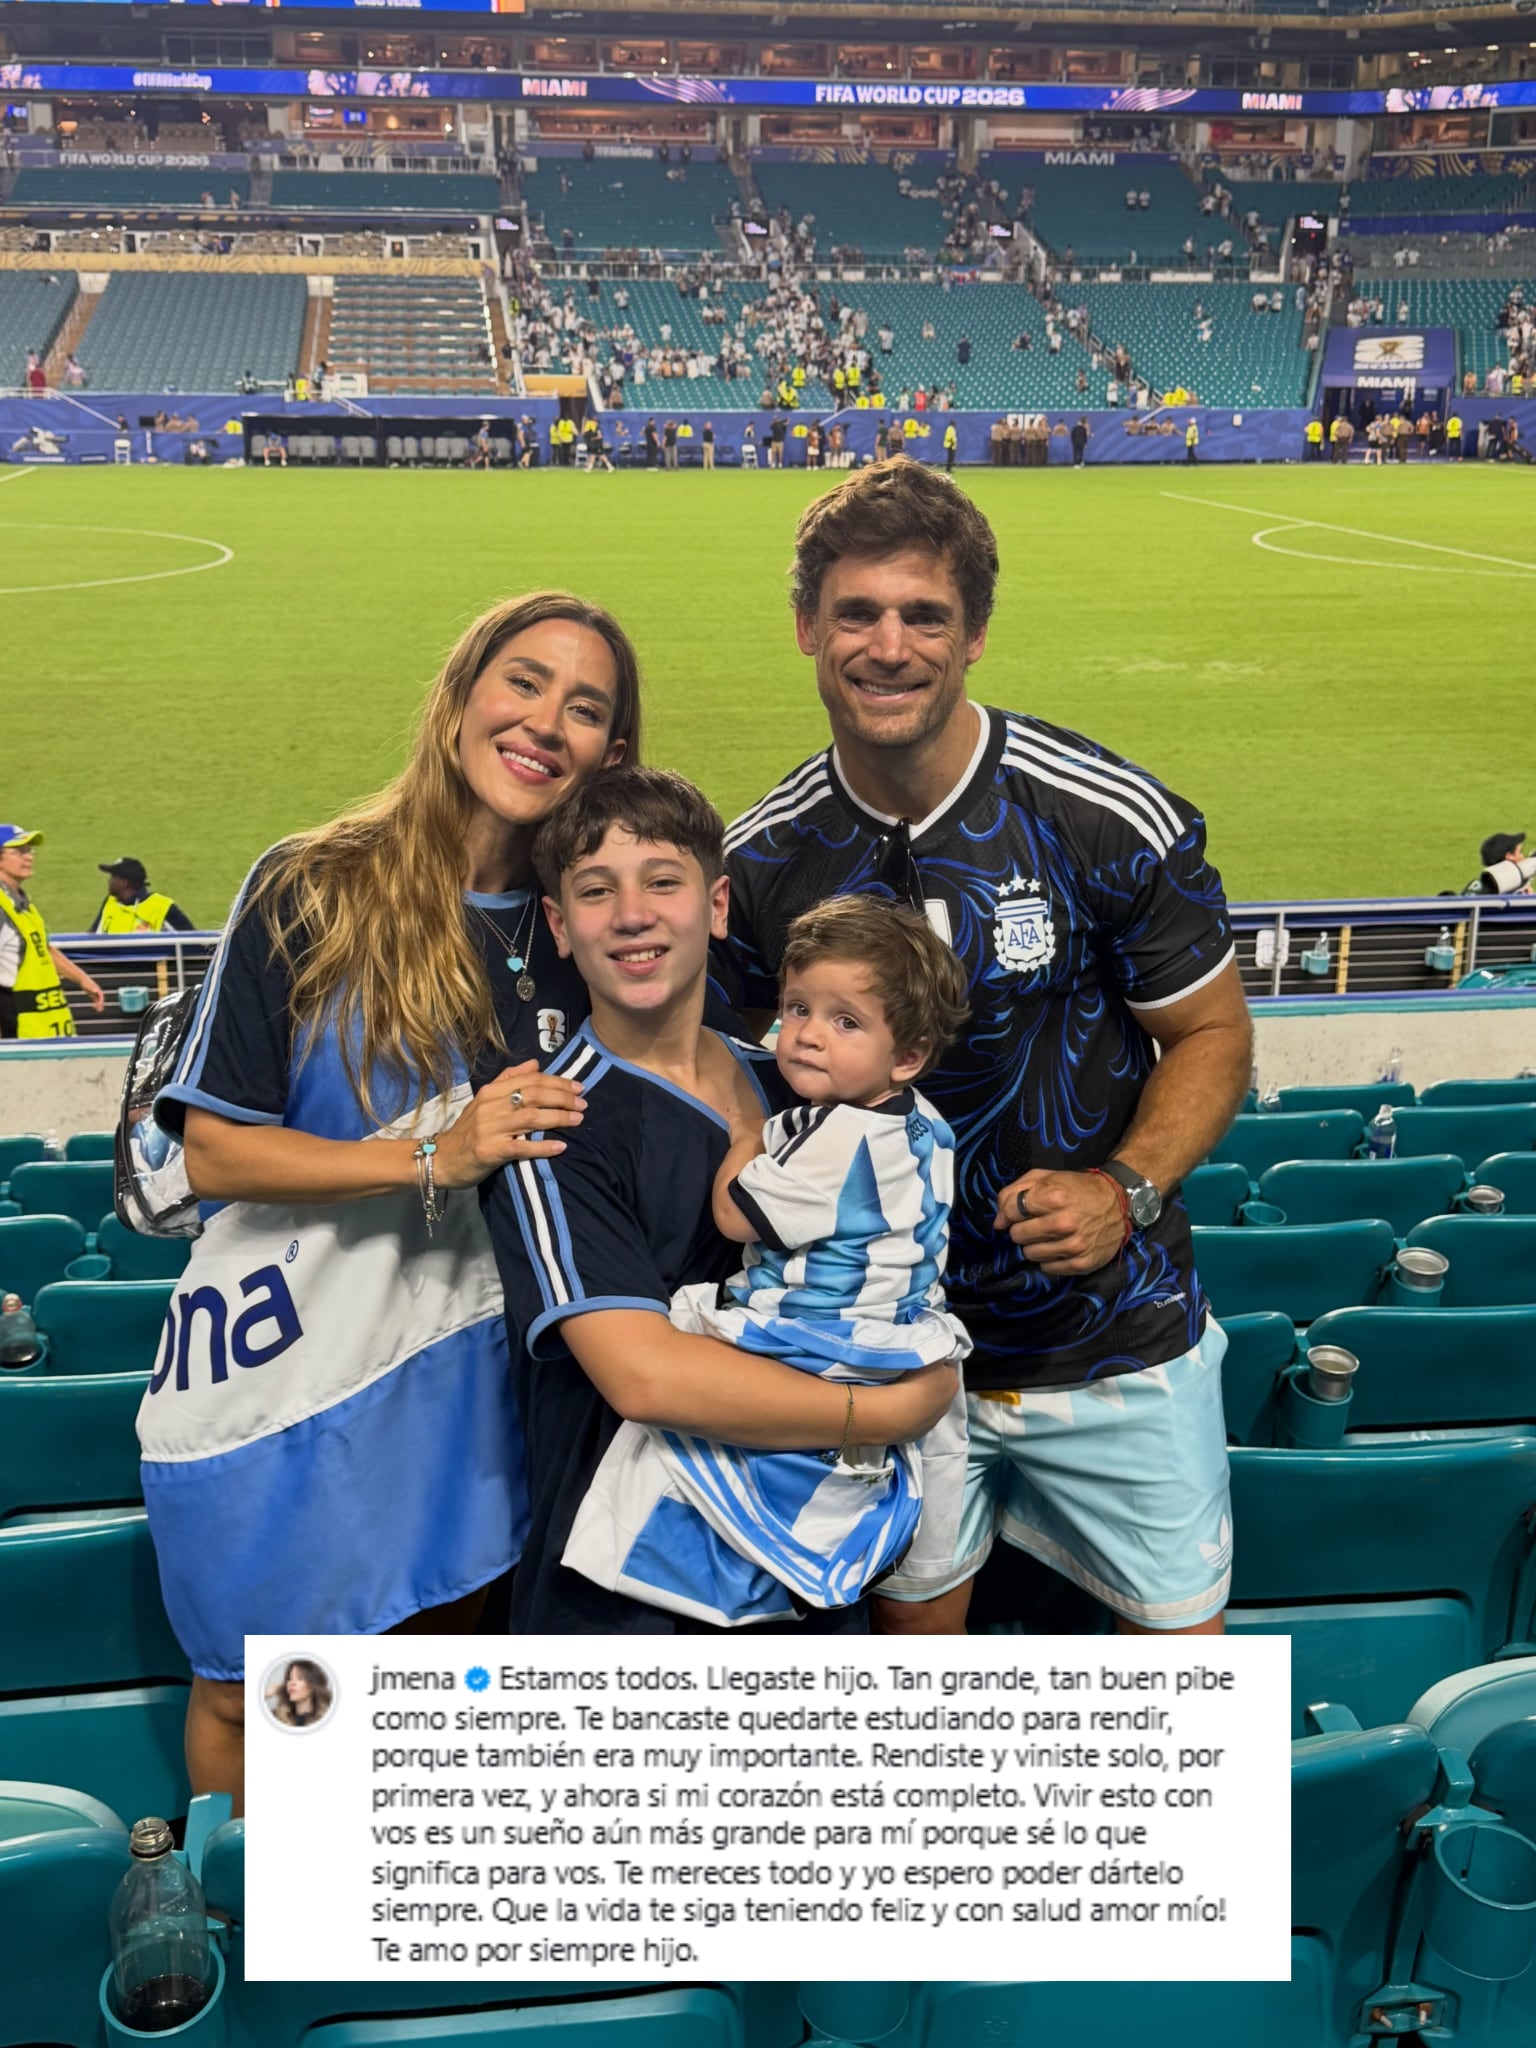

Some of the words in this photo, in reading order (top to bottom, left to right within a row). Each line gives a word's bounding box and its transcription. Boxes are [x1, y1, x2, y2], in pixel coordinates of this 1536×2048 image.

[522, 78, 587, 96] MIAMI
[815, 85, 855, 103] FIFA
[856, 86, 922, 104] WORLD
[924, 87, 960, 105] CUP
[961, 87, 1025, 105] 2026
[1242, 92, 1303, 110] MIAMI
[59, 153, 88, 165] FIFA
[88, 153, 135, 166] WORLD
[137, 154, 163, 166] CUP
[1044, 152, 1115, 165] MIAMI
[1357, 376, 1417, 389] MIAMI
[1007, 917, 1042, 950] AFA
